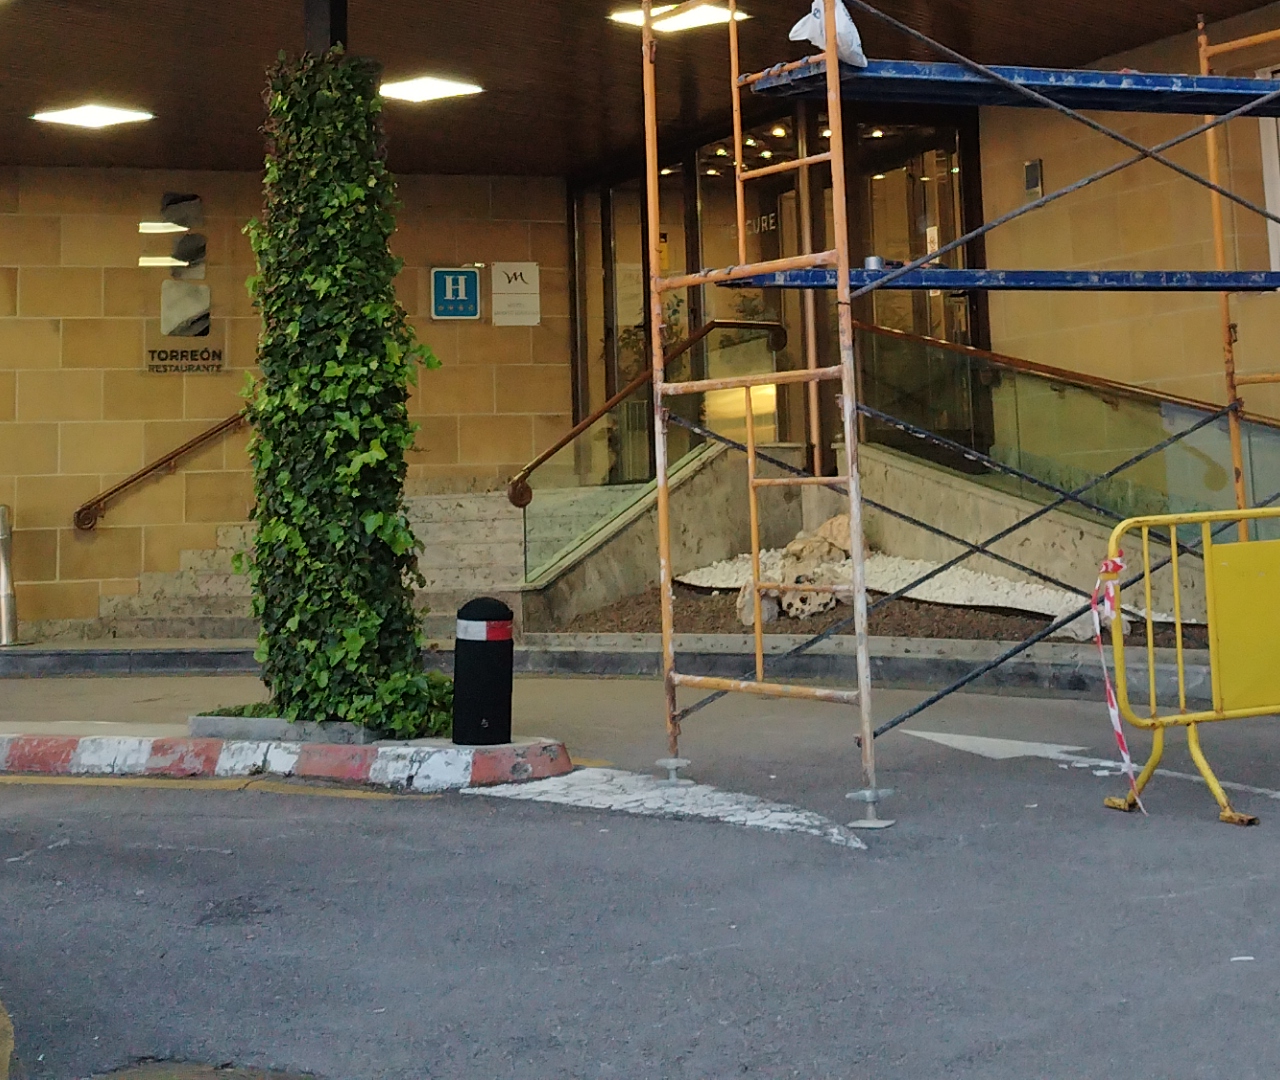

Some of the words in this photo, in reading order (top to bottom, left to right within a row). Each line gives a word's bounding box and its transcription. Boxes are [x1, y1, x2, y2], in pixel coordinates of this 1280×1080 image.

[444, 275, 468, 300] H
[148, 347, 222, 361] TORREÓN
[148, 364, 222, 373] RESTAURANTE
